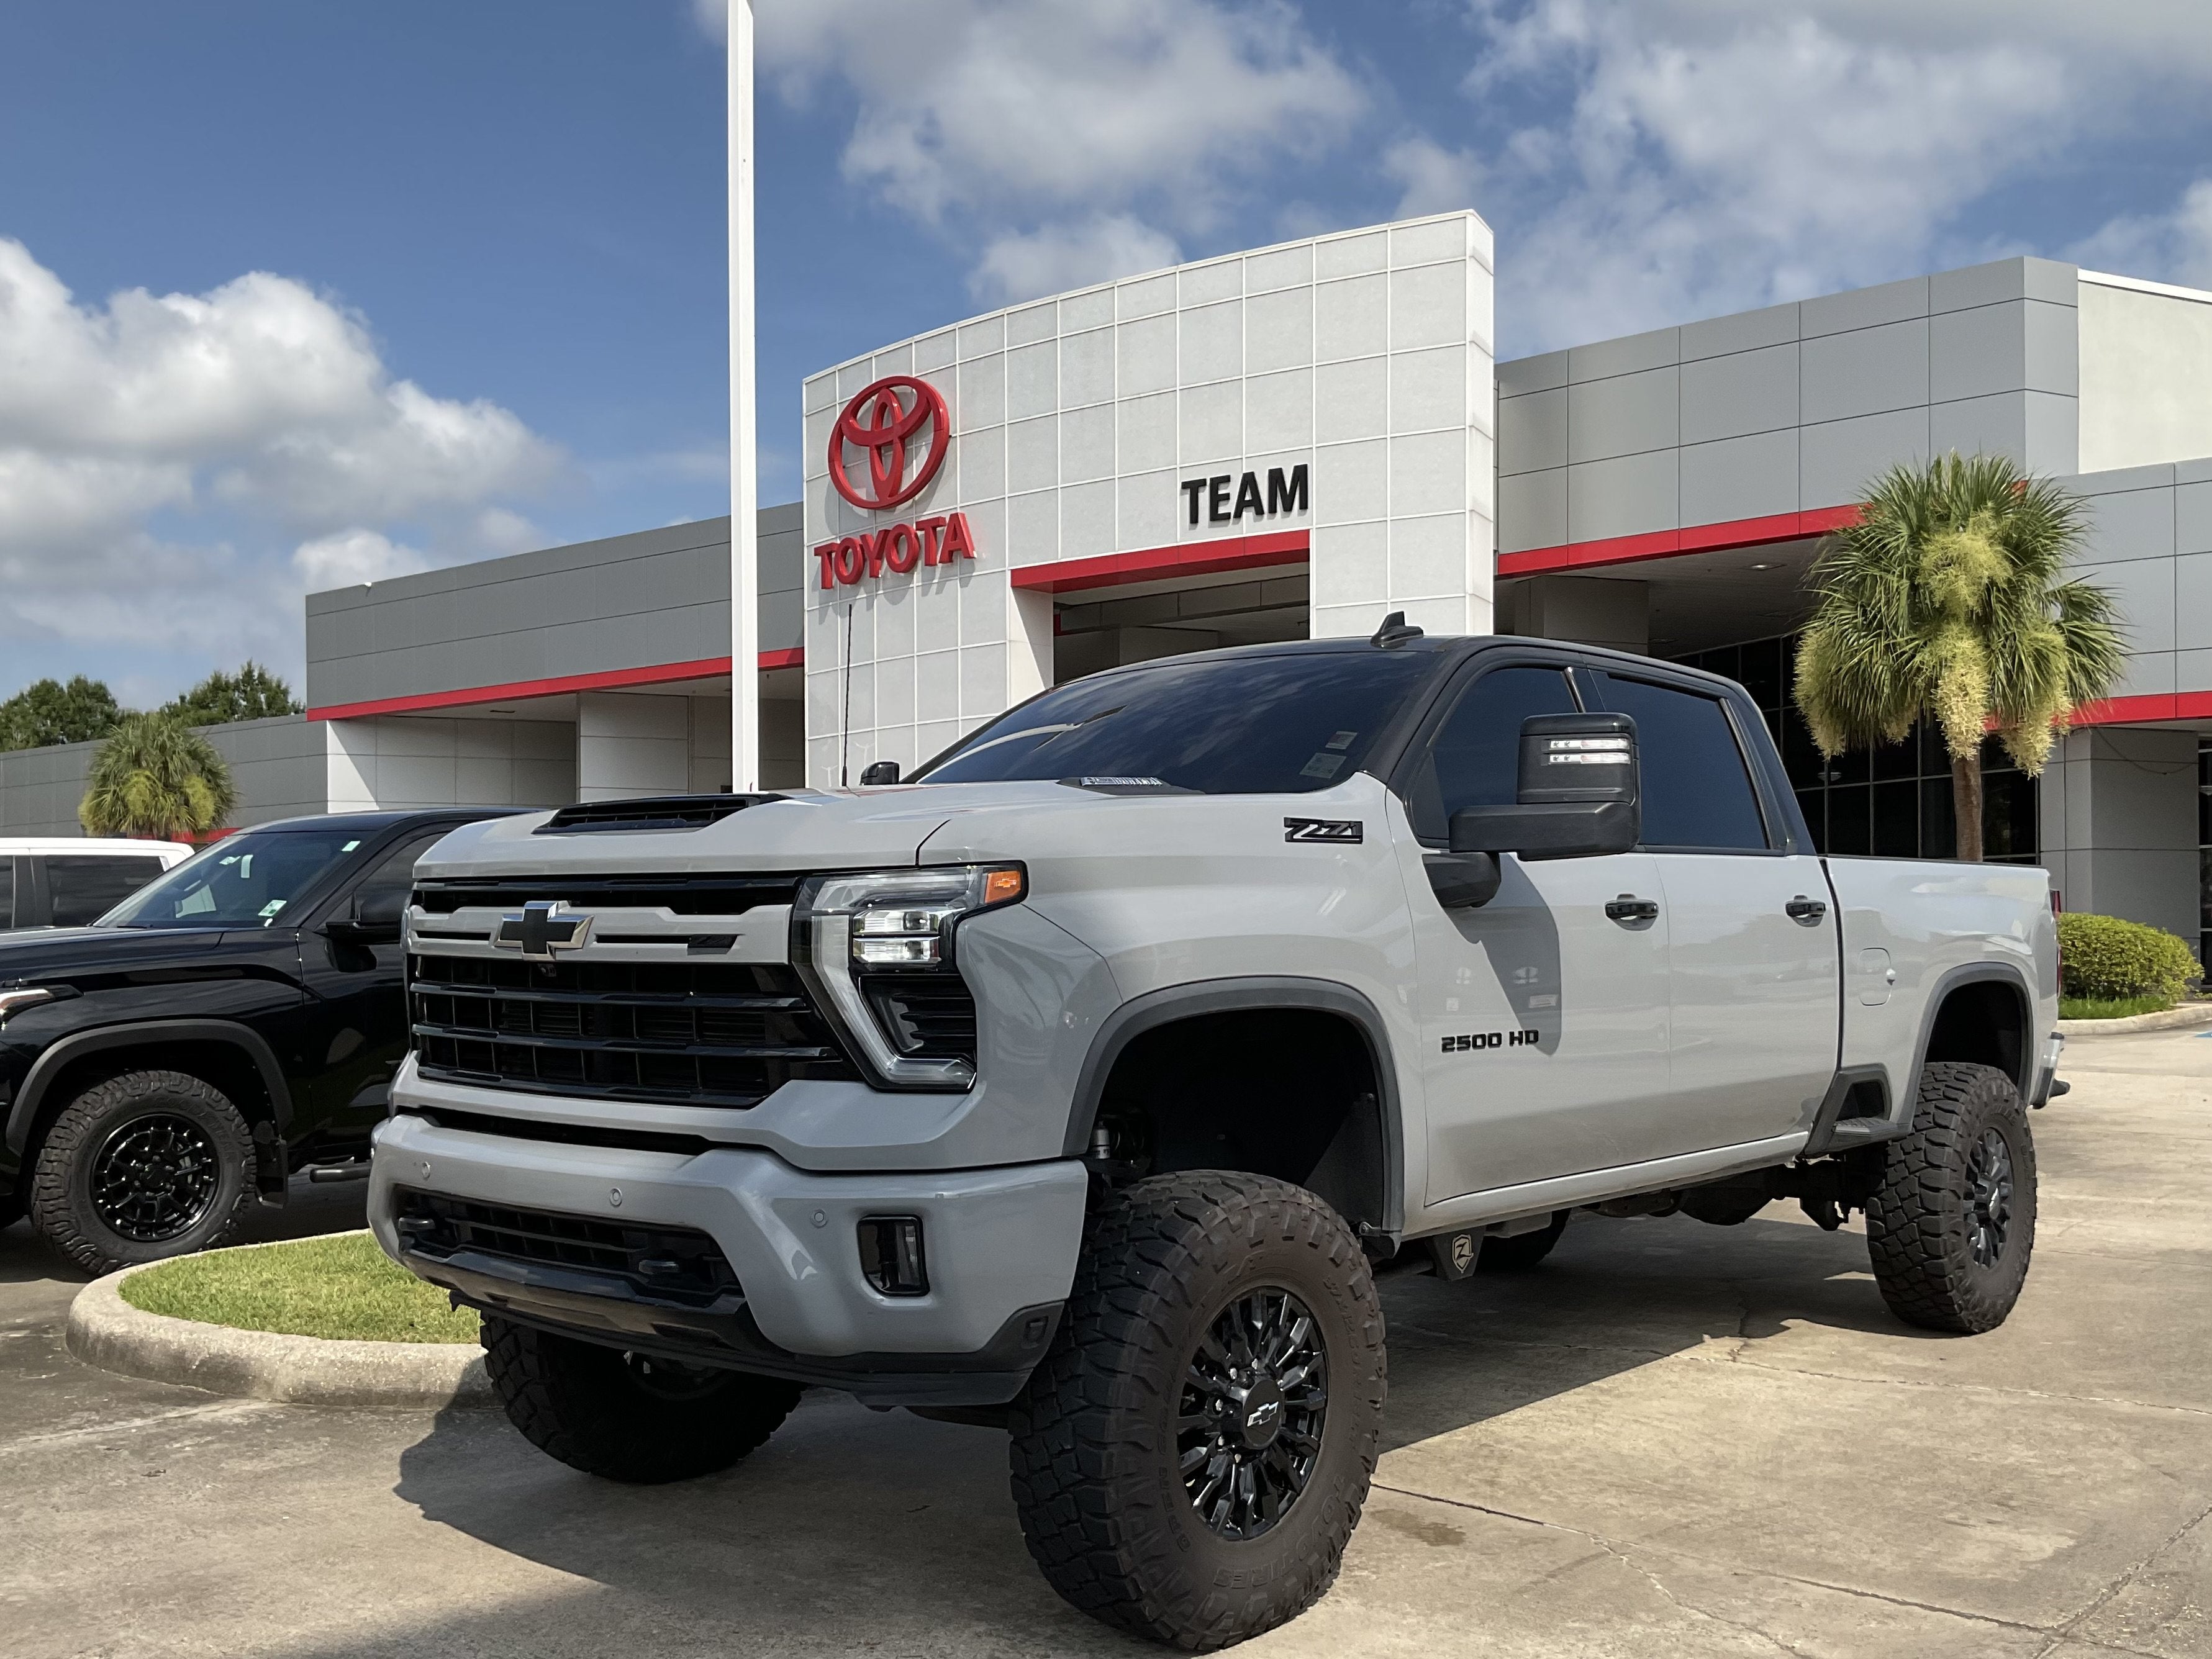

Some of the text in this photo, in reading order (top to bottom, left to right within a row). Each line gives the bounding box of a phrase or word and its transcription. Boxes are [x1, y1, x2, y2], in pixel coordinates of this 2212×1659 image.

[1181, 464, 1309, 524] TEAM
[814, 512, 976, 589] TOYOTA
[1284, 817, 1363, 844] Z71
[1441, 1029, 1539, 1053] 2500 HD
